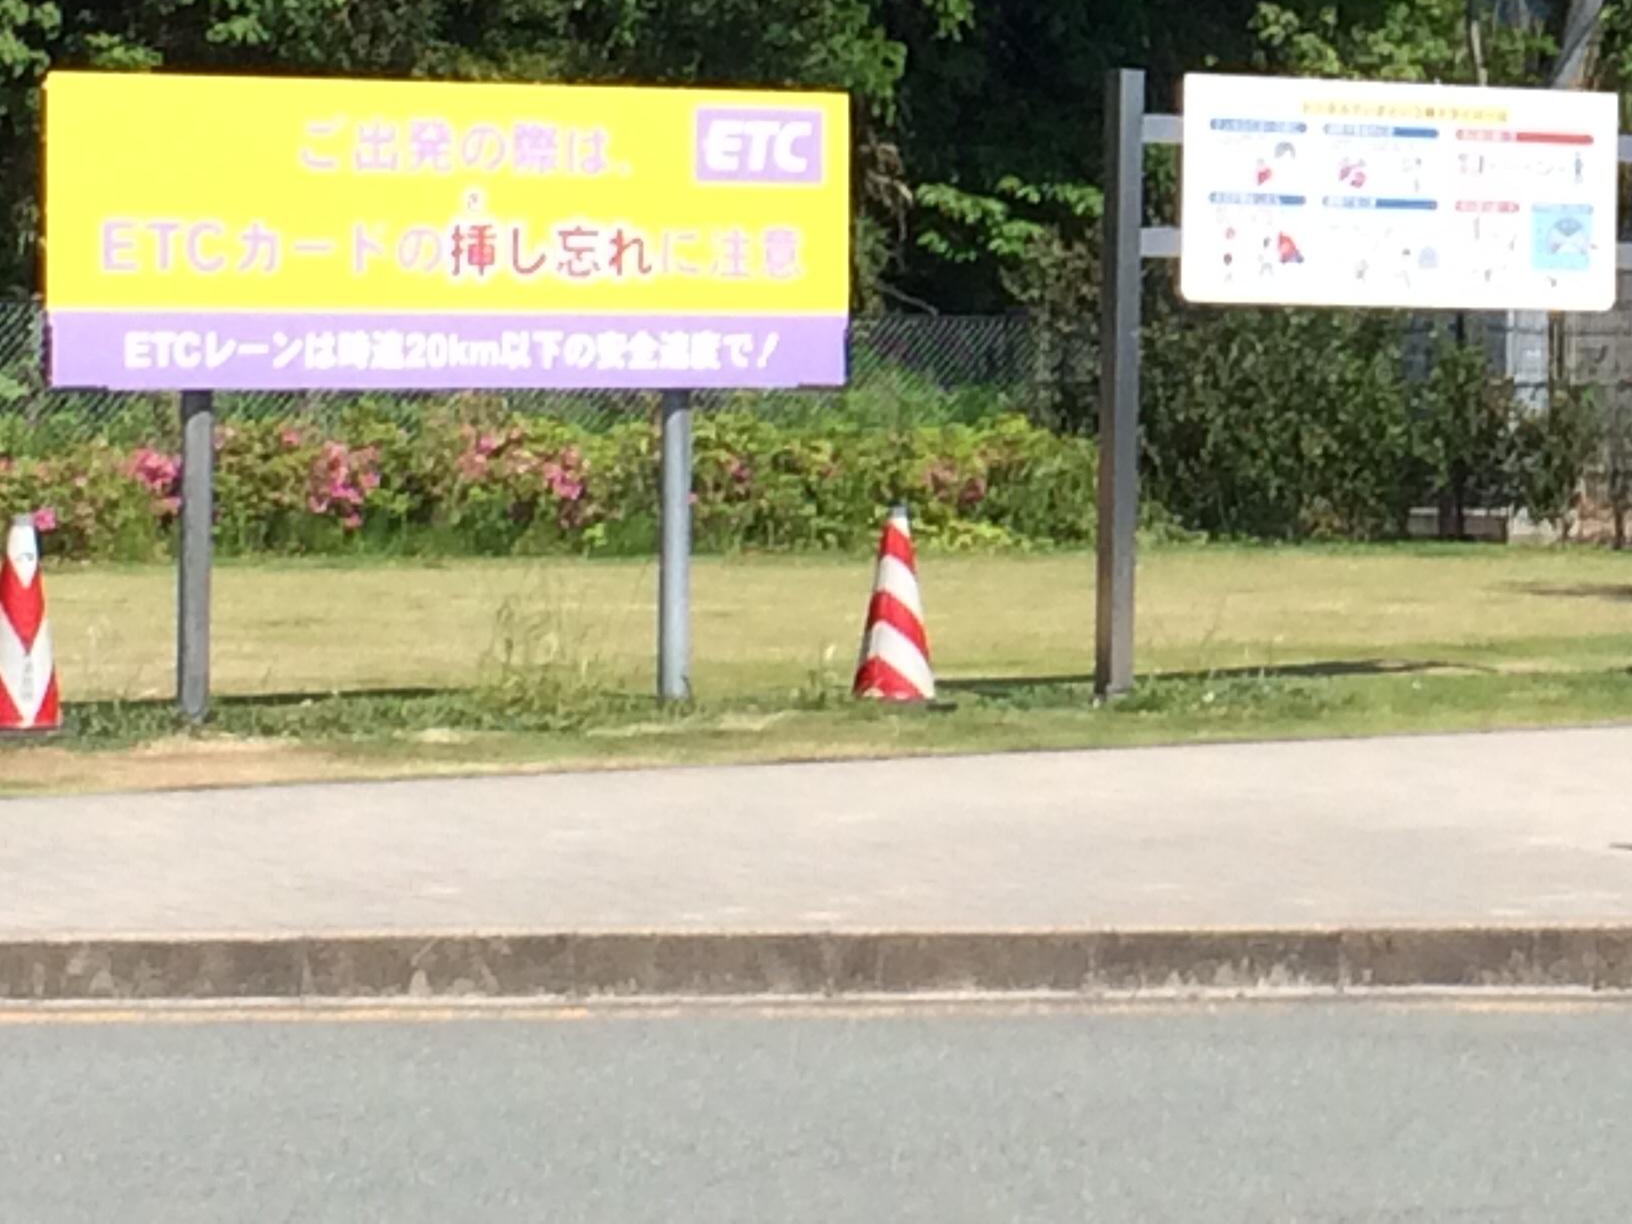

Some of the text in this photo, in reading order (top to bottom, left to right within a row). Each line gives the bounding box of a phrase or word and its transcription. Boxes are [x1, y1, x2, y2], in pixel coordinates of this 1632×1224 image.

[705, 122, 813, 173] ETC
[102, 220, 803, 278] ETCカードの挿し忘れに注意
